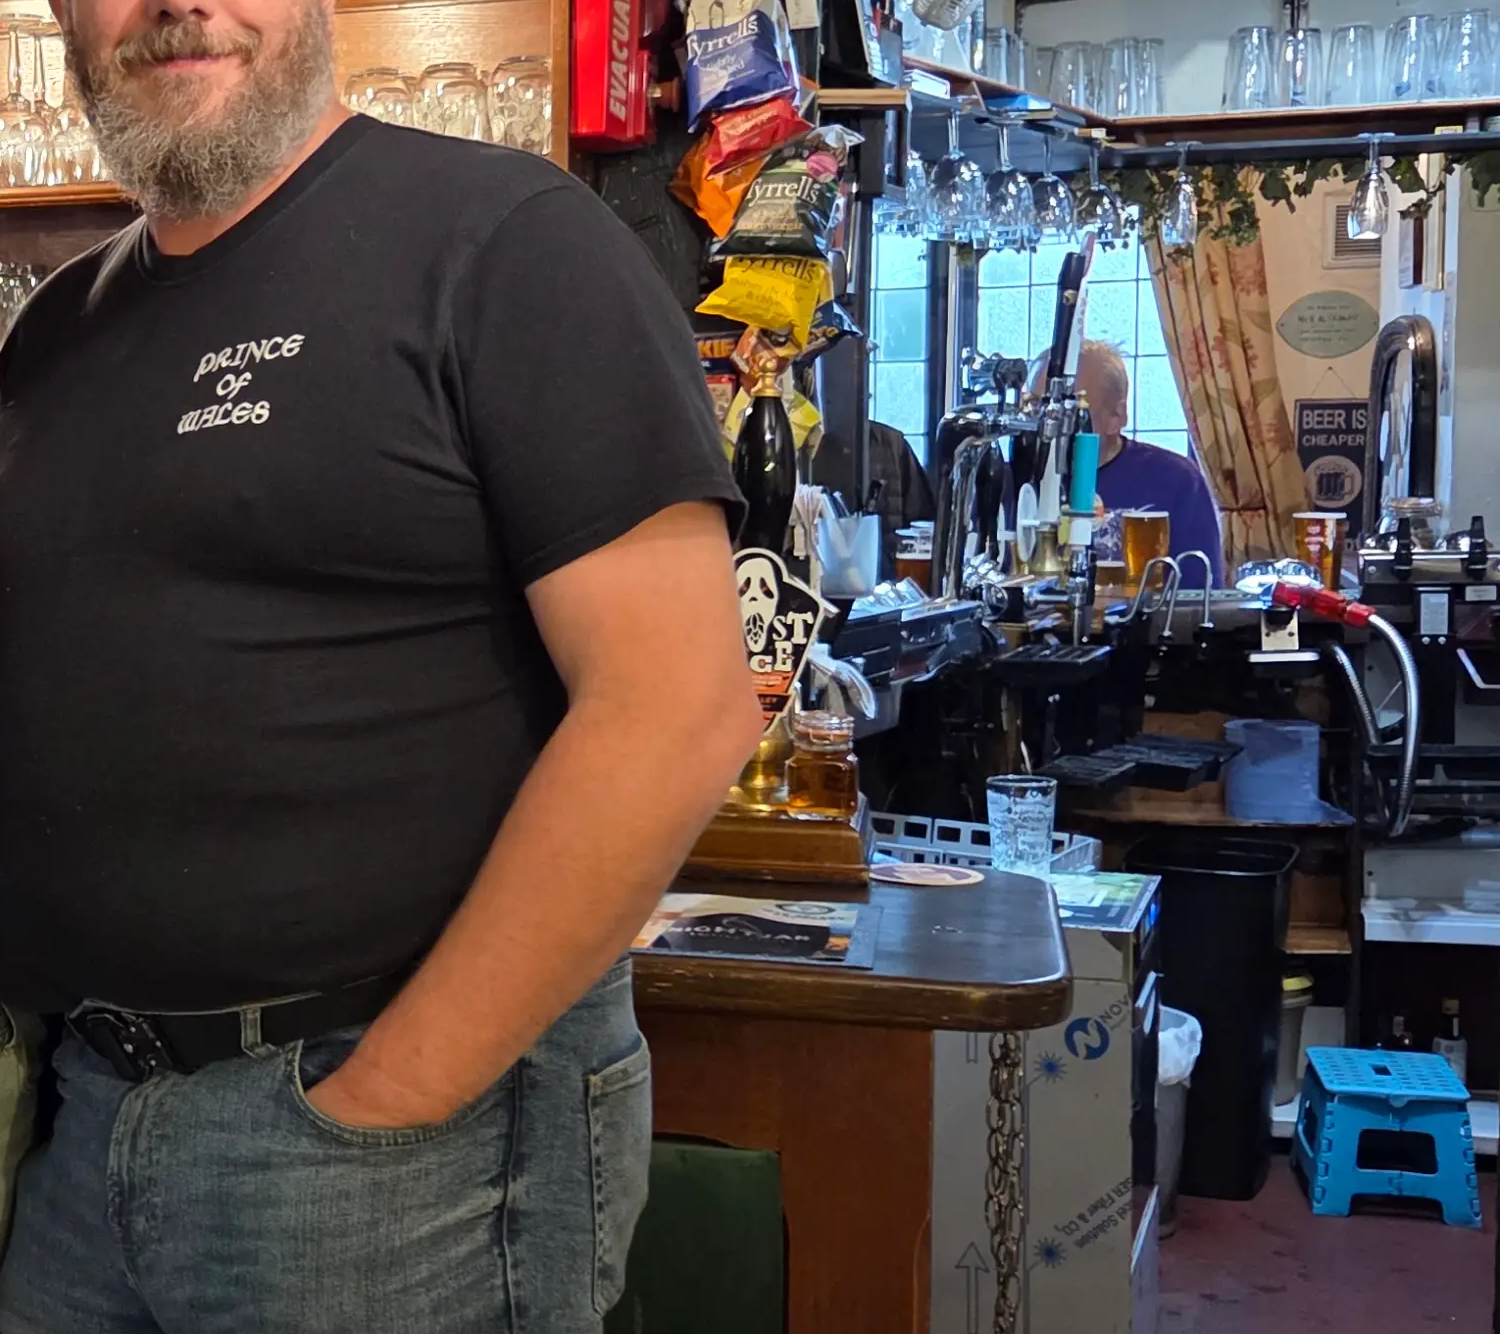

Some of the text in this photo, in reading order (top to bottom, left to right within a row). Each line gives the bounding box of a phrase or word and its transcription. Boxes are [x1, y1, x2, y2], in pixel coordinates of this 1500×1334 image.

[193, 333, 306, 382] PRINCE
[177, 400, 270, 434] WALES
[1302, 409, 1367, 430] BEER IS
[1302, 434, 1365, 447] CHEAPER
[1087, 1191, 1116, 1217] Fiber
